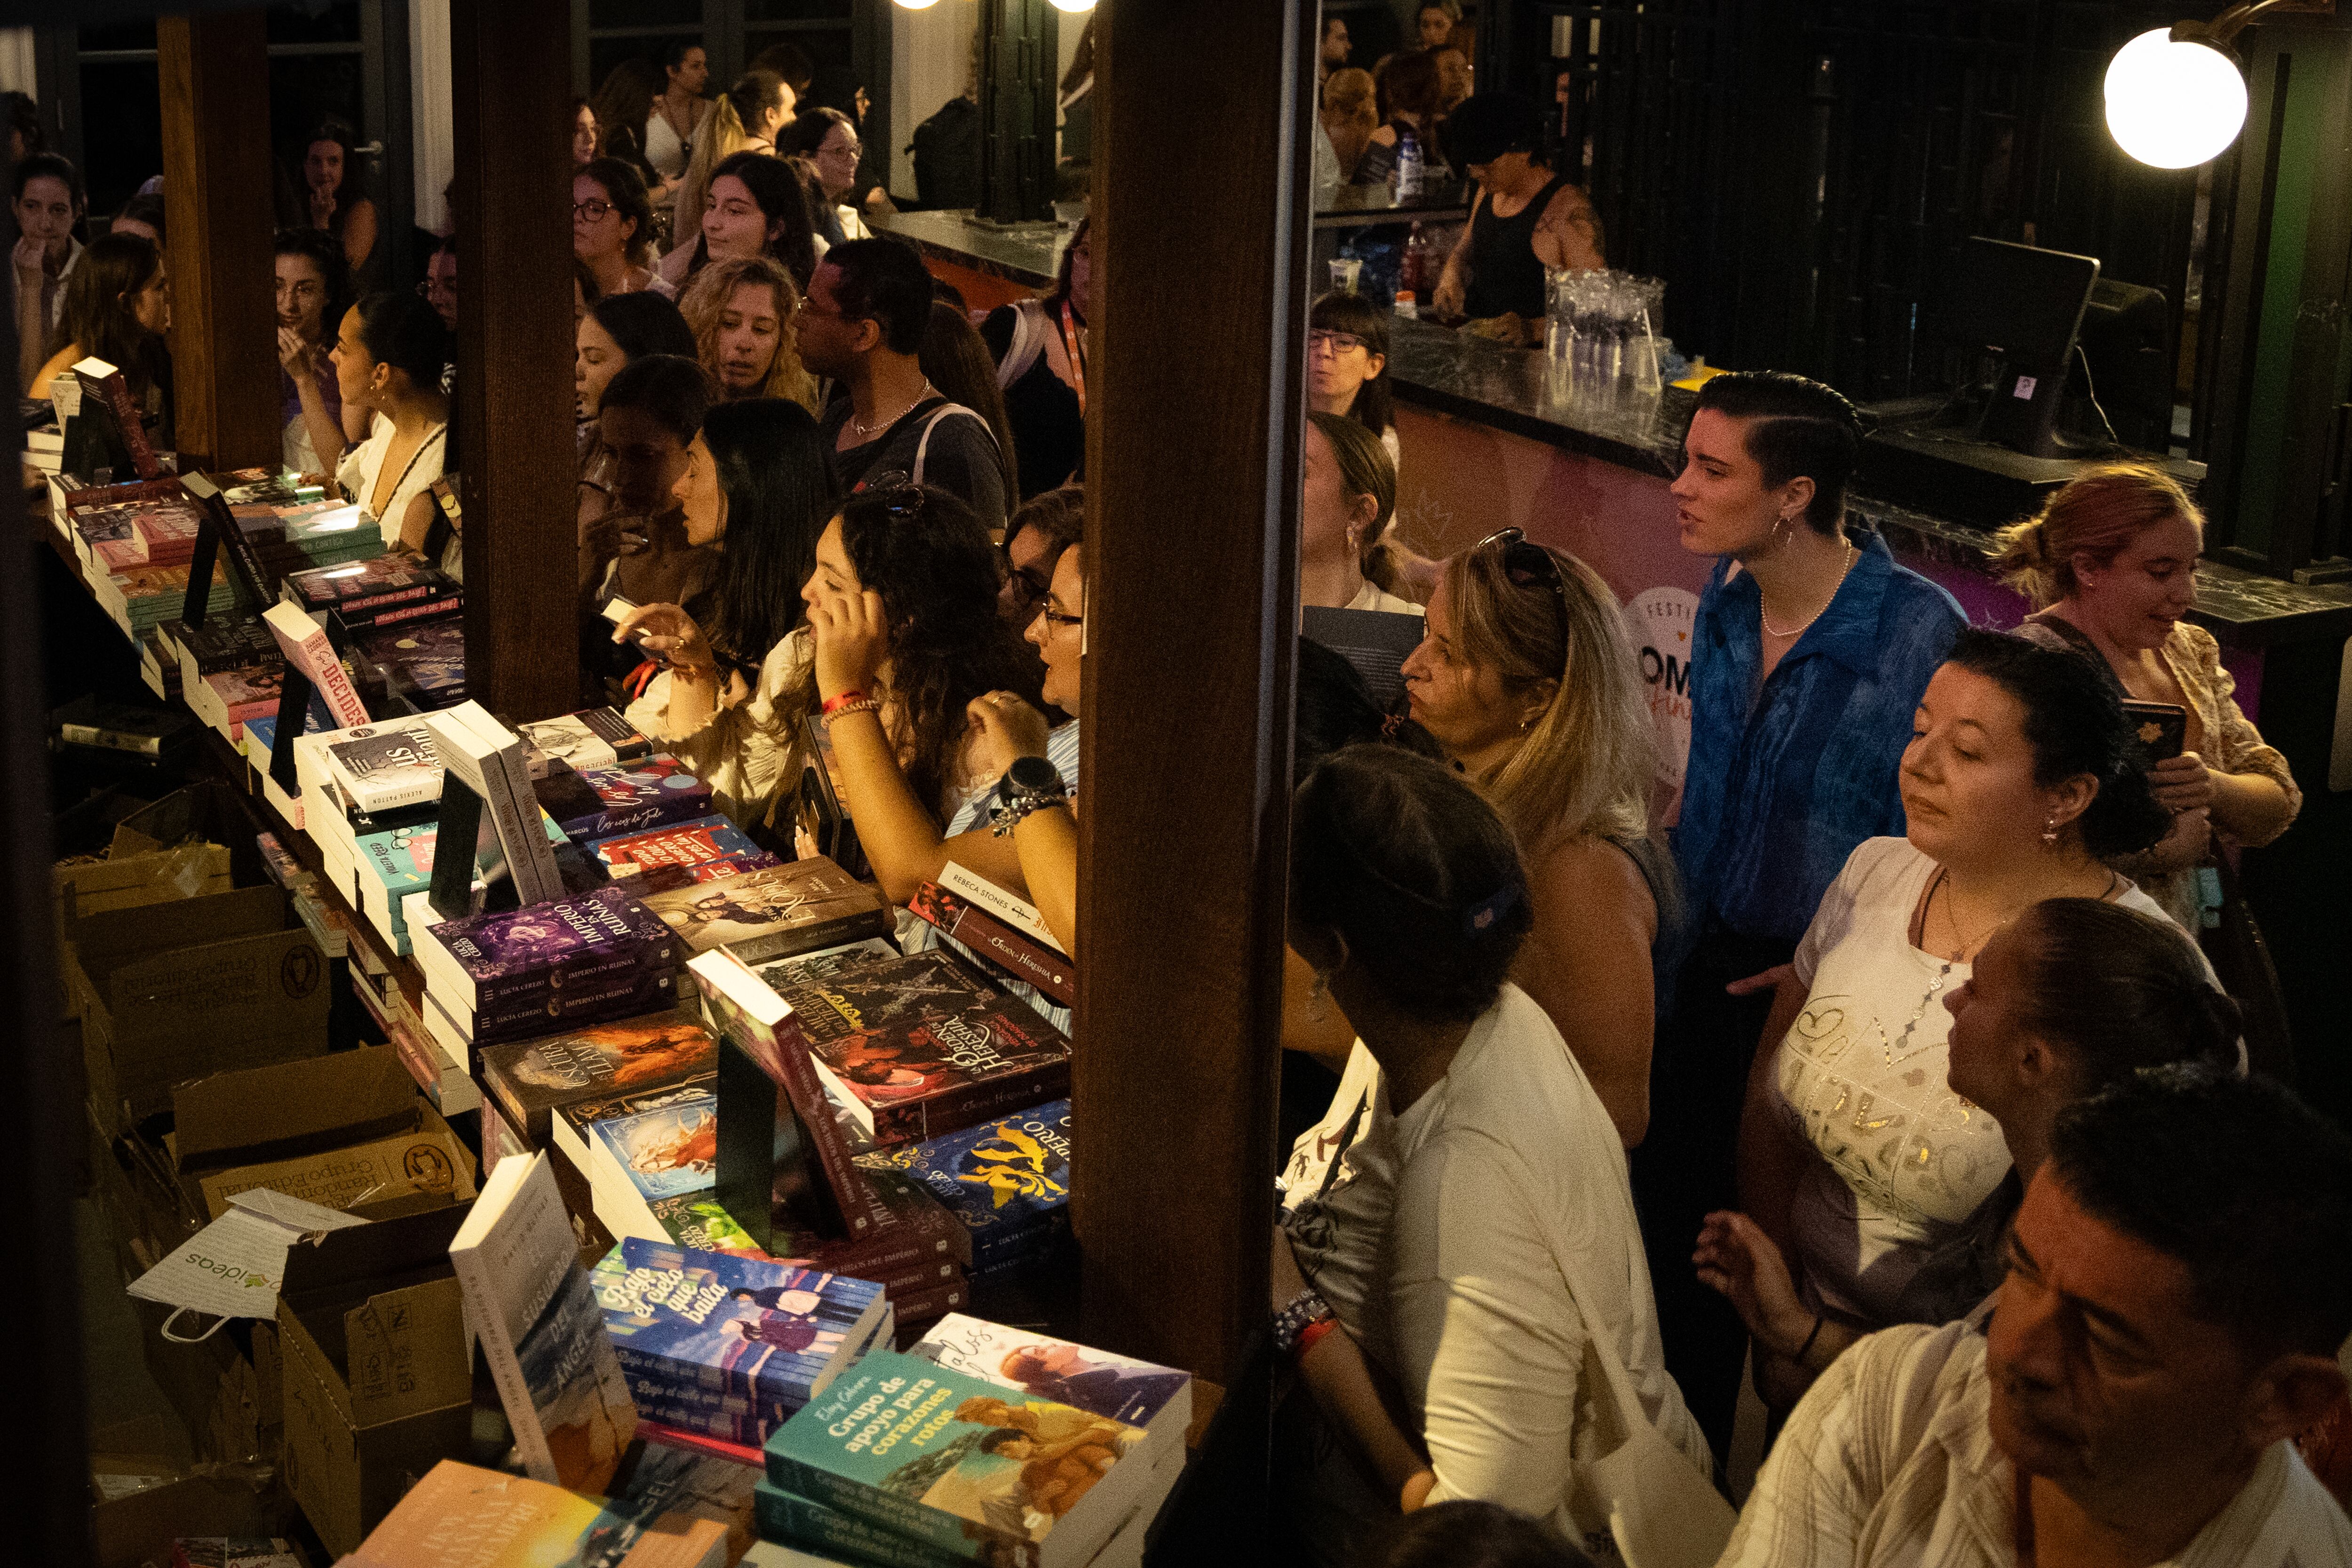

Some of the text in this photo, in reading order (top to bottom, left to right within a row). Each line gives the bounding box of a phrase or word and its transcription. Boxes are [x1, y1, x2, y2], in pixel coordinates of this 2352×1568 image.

[323, 663, 366, 727] DECIDES
[373, 790, 422, 804] ALEXIS PATTON
[379, 856, 399, 876] VIOLETA
[953, 874, 1009, 909] REBECA STONES
[554, 904, 604, 944] IMPERIO
[582, 899, 632, 936] RUINAS
[585, 914, 599, 924] EN
[452, 941, 470, 958] LUCÍA
[460, 937, 482, 957] CEREZO
[992, 937, 1051, 980] ORDEN HERESHIA
[500, 985, 519, 996] LUCÍA
[521, 979, 545, 991] CEREZO
[568, 966, 596, 979] IMPERIO
[597, 964, 608, 973] EN
[608, 958, 636, 970] RUINAS
[497, 1012, 517, 1024] LUCÍA
[517, 1007, 542, 1019] CEREZO
[565, 995, 595, 1008] IMPERIO
[596, 993, 605, 1002] EN
[606, 987, 634, 999] RUINAS
[943, 1015, 1014, 1071] HERESHIA
[310, 1159, 374, 1183] Grupo
[184, 1252, 247, 1285] ideas
[602, 1267, 657, 1308] Bajo
[522, 1250, 571, 1329] SUSURRO
[634, 1268, 684, 1319] el cielo
[667, 1282, 698, 1316] que
[681, 1282, 730, 1325] baila
[828, 1377, 906, 1437] Grupo de
[845, 1378, 936, 1453] apoyo para
[871, 1388, 953, 1455] corazones
[910, 1409, 954, 1447] rotos
